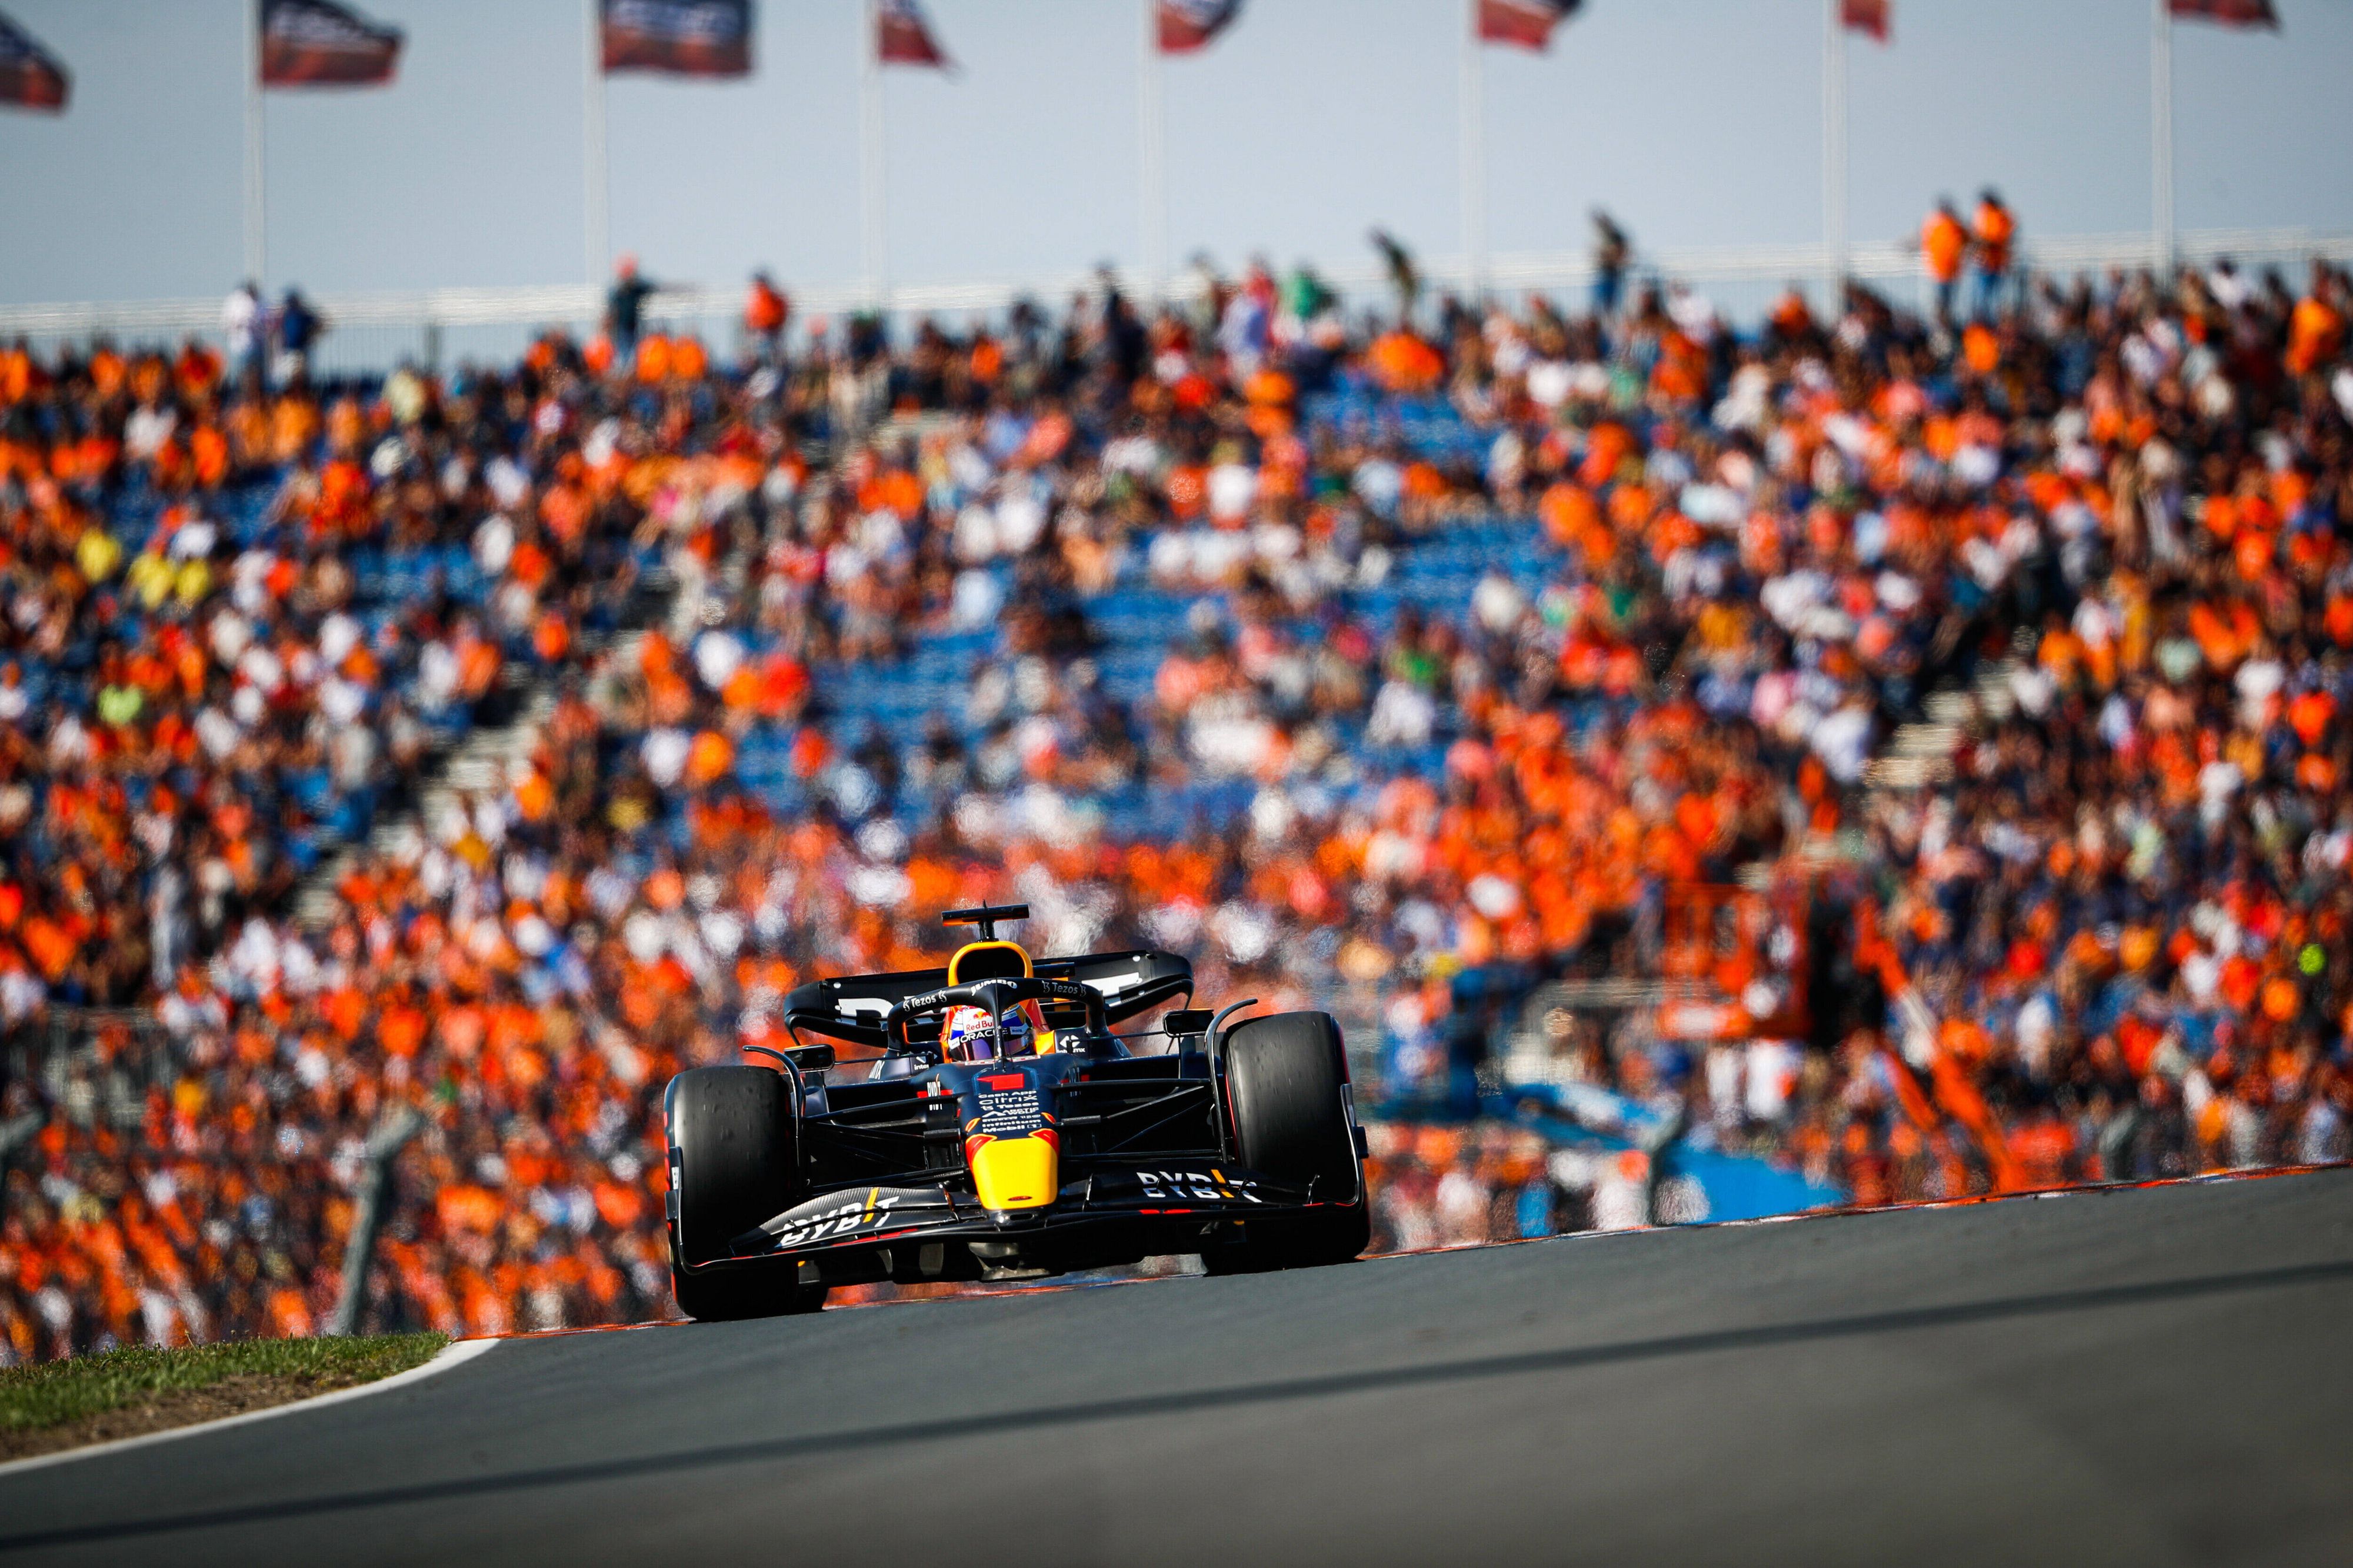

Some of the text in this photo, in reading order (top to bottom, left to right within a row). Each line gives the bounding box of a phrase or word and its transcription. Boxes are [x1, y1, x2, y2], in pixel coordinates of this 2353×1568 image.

[971, 979, 1018, 996] JUMBO
[1052, 982, 1078, 994] Tezos
[911, 995, 936, 1008] Tezos
[966, 1021, 981, 1032] Red
[976, 1073, 1024, 1091] 1
[982, 1125, 1025, 1133] Mobil
